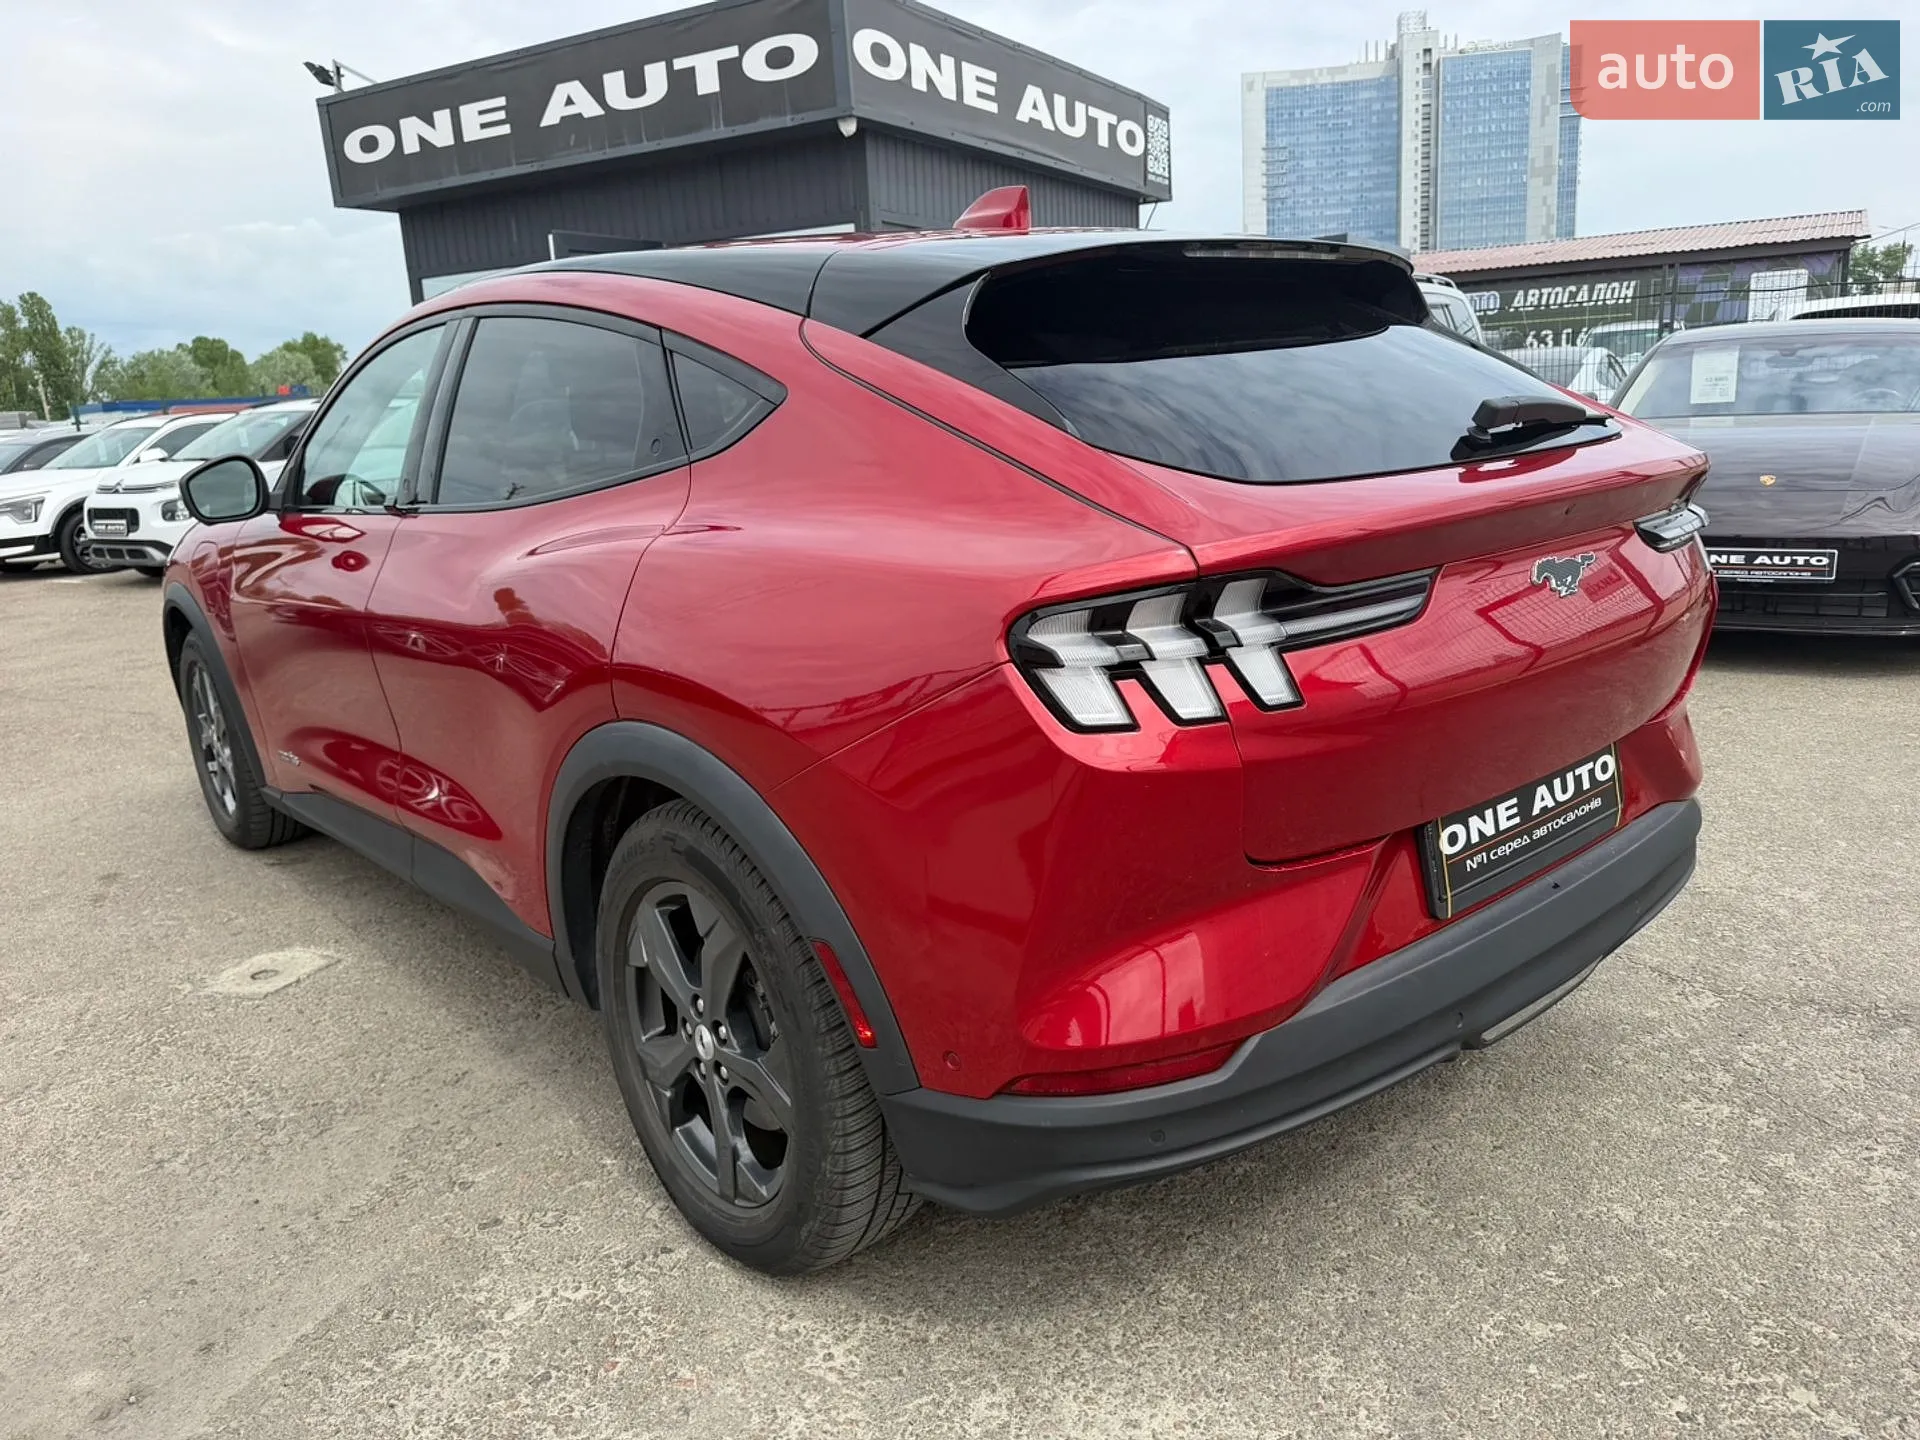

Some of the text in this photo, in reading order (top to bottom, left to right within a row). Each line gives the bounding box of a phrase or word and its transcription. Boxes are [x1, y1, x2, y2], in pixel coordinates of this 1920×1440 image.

[343, 32, 819, 165] ONE AUTO
[852, 28, 1146, 157] ONE AUTO
[1509, 280, 1637, 312] АВТОСАЛОН
[1709, 554, 1830, 566] NE AUTO
[1439, 797, 1521, 855] ONE
[1531, 753, 1616, 817] AUTO
[1489, 836, 1531, 861] серед
[1532, 796, 1603, 840] автосалонів
